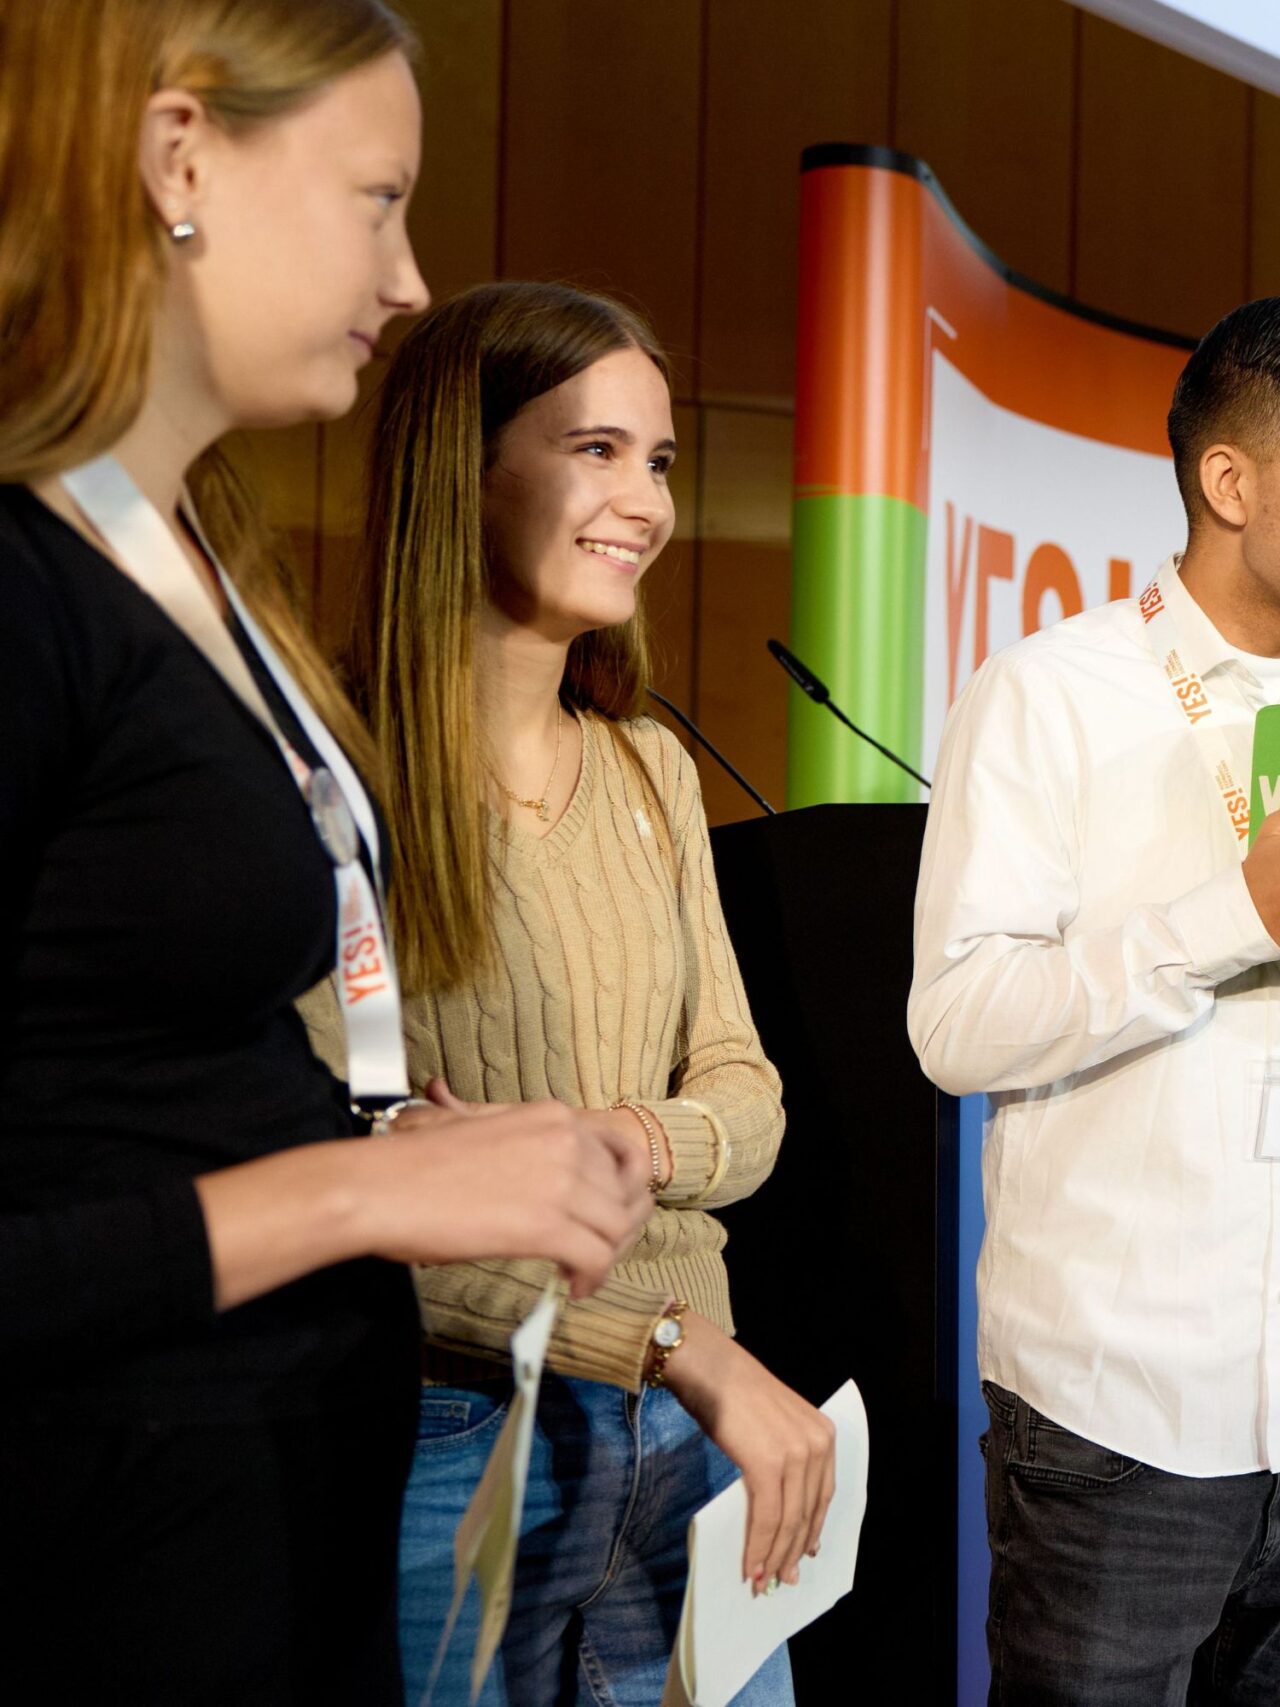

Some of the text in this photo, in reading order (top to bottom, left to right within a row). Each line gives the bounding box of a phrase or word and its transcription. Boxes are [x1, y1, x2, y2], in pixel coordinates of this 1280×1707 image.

[1139, 581, 1166, 625] YES!
[1171, 672, 1213, 726] YES!
[1222, 787, 1251, 842] YES!
[342, 921, 388, 1006] YES!
